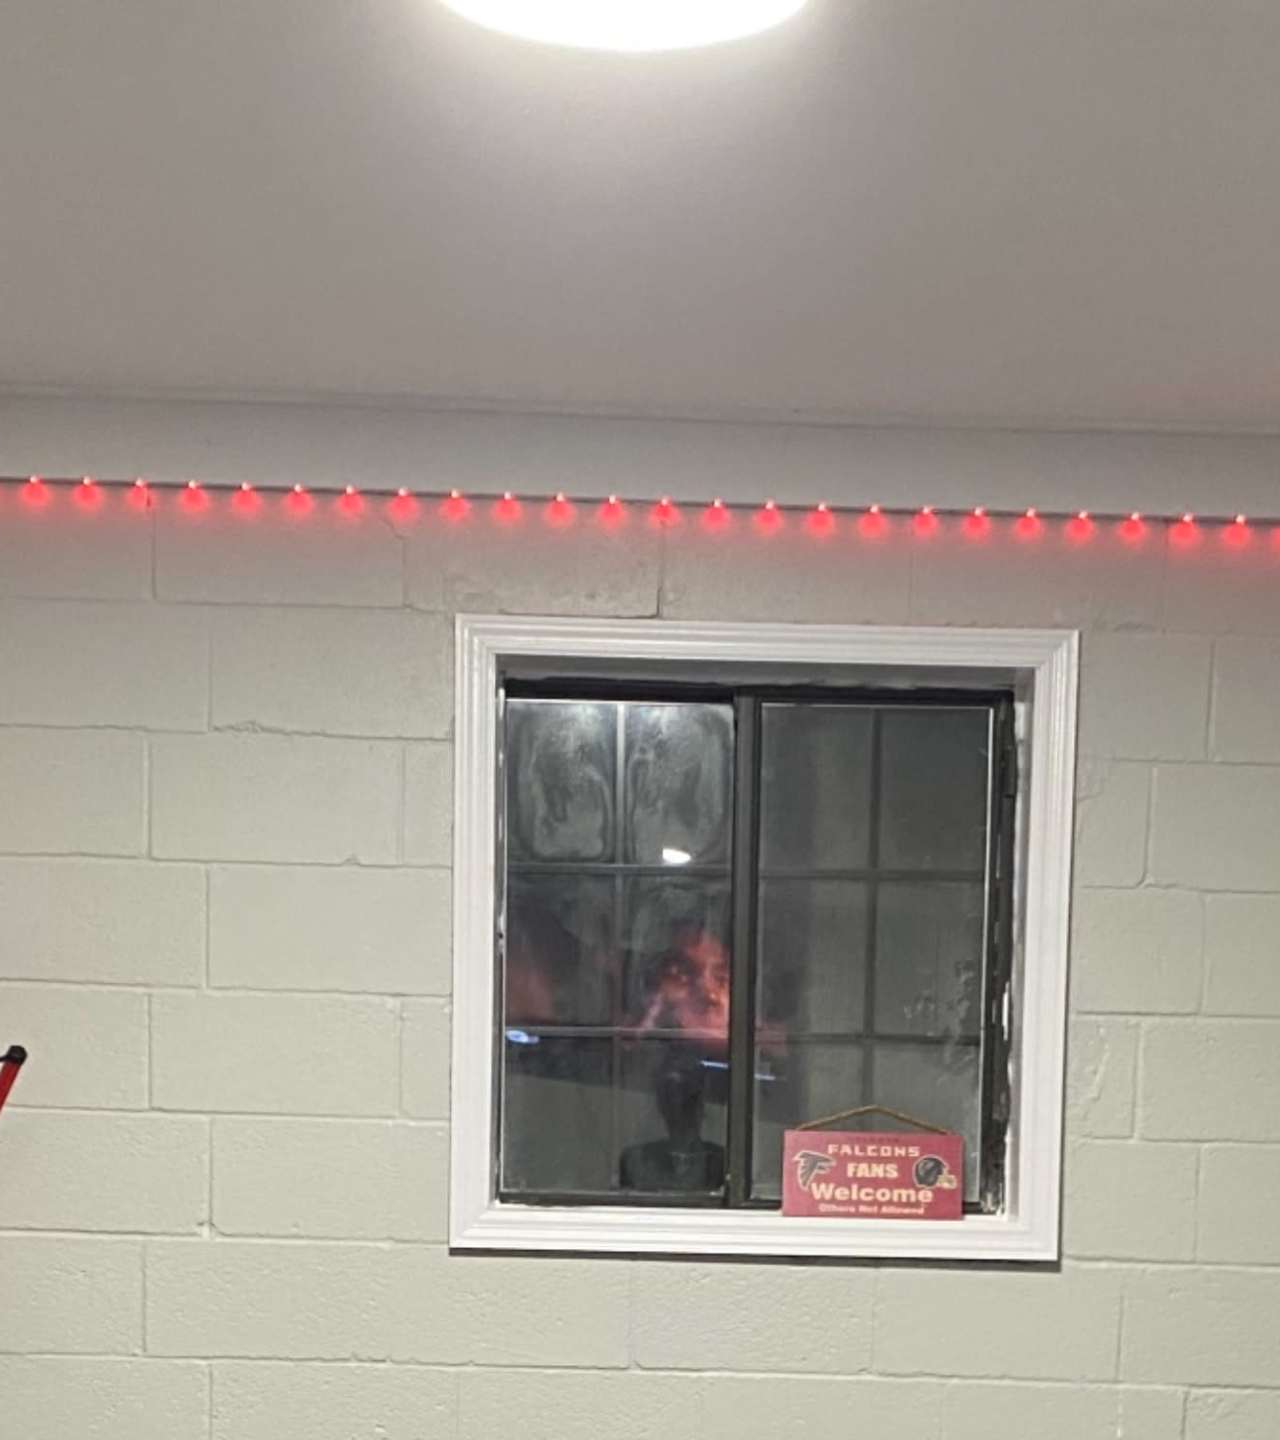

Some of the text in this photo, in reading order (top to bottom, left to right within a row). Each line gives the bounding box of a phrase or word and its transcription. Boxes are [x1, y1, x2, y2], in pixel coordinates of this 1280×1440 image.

[827, 1144, 921, 1157] FALCONS
[847, 1162, 899, 1178] FANS
[811, 1182, 934, 1203] Welcome
